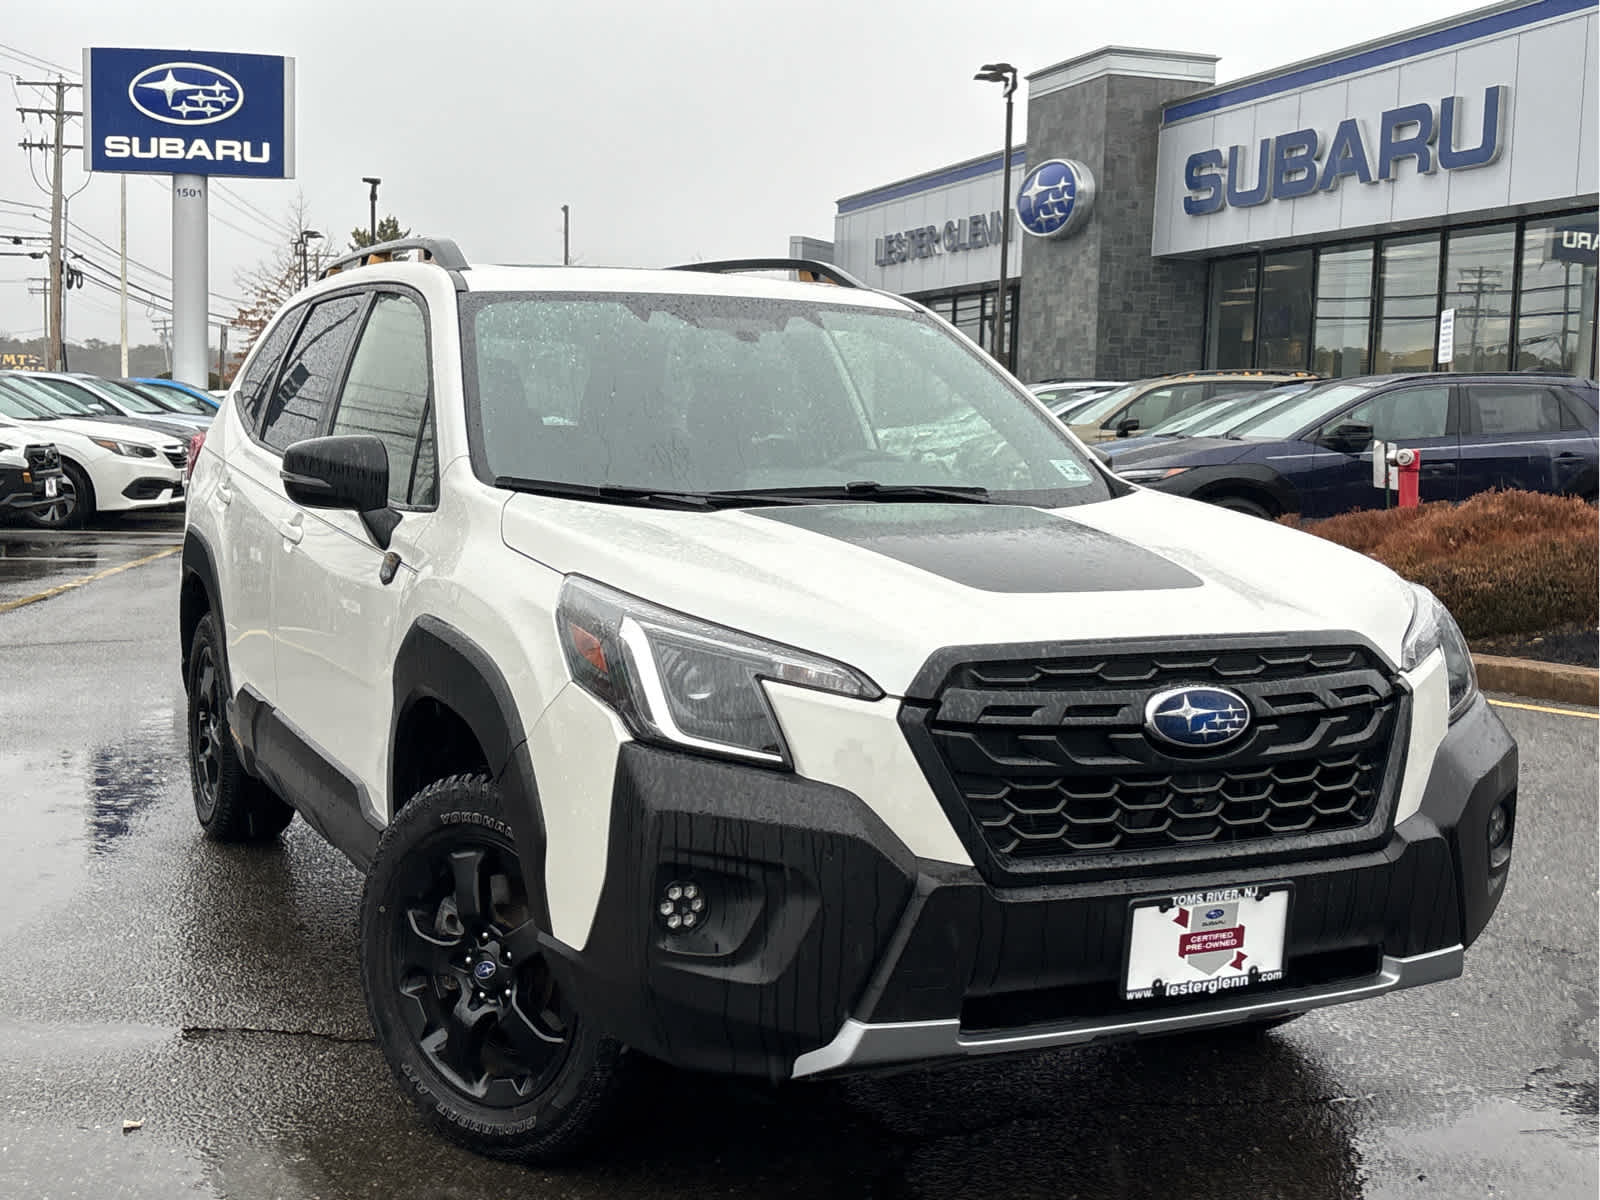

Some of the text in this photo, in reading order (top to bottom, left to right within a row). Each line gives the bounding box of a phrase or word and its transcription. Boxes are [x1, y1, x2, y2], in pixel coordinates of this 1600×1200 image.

[104, 135, 270, 163] SUBARU
[1184, 85, 1507, 216] SUBARU
[176, 188, 202, 198] 1501
[875, 225, 938, 267] LESTER
[440, 811, 515, 838] YOKOHAM
[1171, 893, 1204, 906] TOMS
[1244, 886, 1259, 897] NJ
[1185, 938, 1238, 952] PRE-OWNED
[1190, 931, 1234, 944] CERTIFIED
